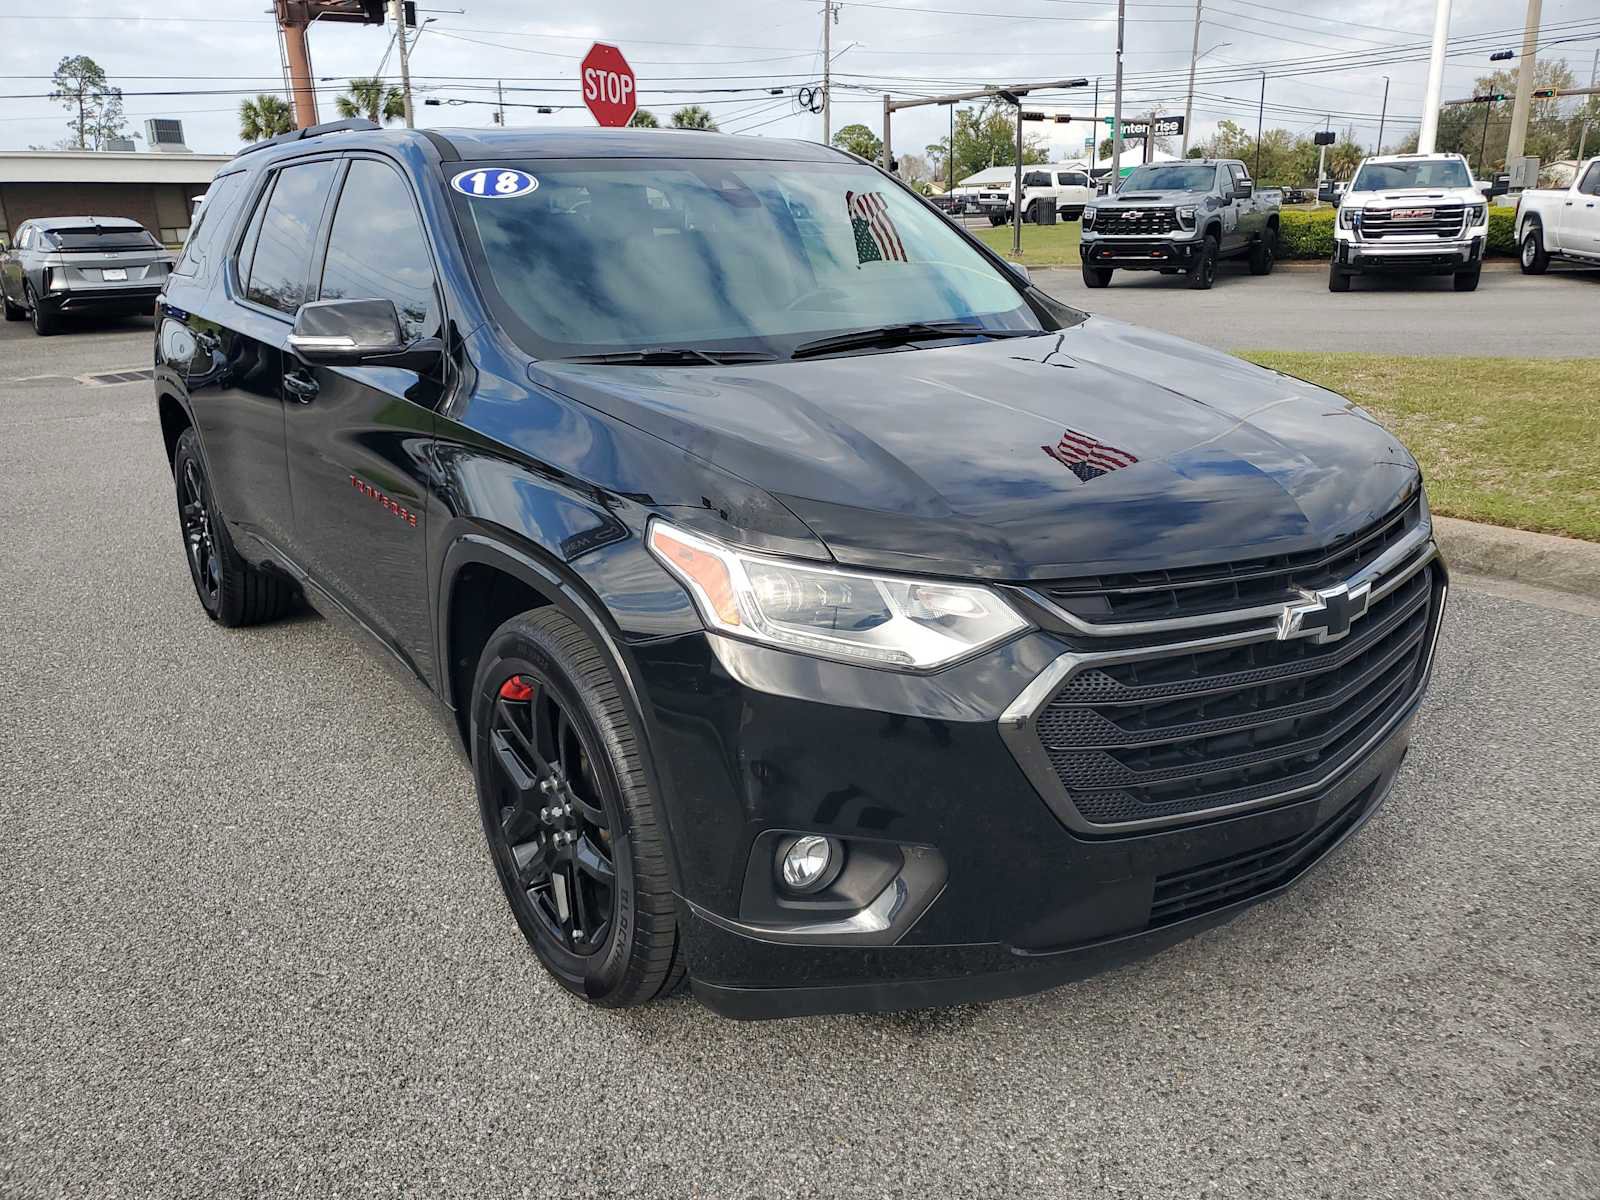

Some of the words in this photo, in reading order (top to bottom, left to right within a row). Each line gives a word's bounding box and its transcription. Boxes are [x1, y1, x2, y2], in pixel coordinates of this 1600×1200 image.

[585, 67, 633, 105] STOP
[470, 171, 519, 195] 18
[349, 474, 417, 528] TRAVERSE
